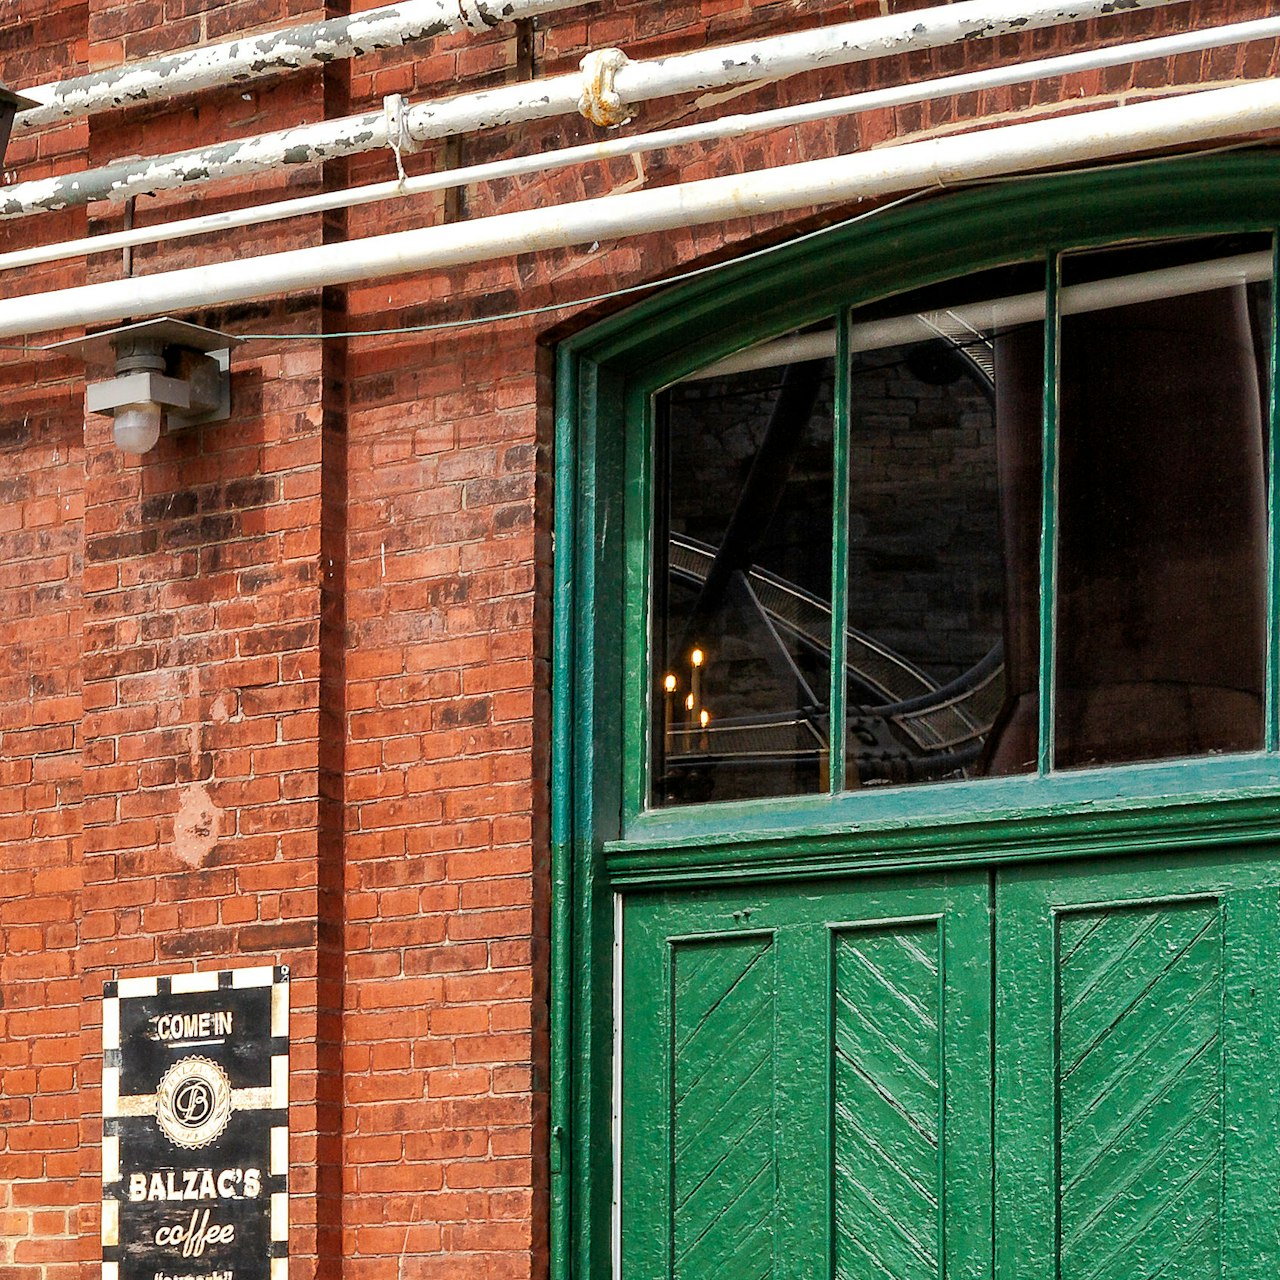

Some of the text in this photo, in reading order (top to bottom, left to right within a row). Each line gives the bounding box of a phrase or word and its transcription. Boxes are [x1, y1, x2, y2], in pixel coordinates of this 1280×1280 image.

[158, 1011, 233, 1040] COME IN
[128, 1168, 261, 1201] BALZAC'S
[155, 1208, 235, 1258] coffee
